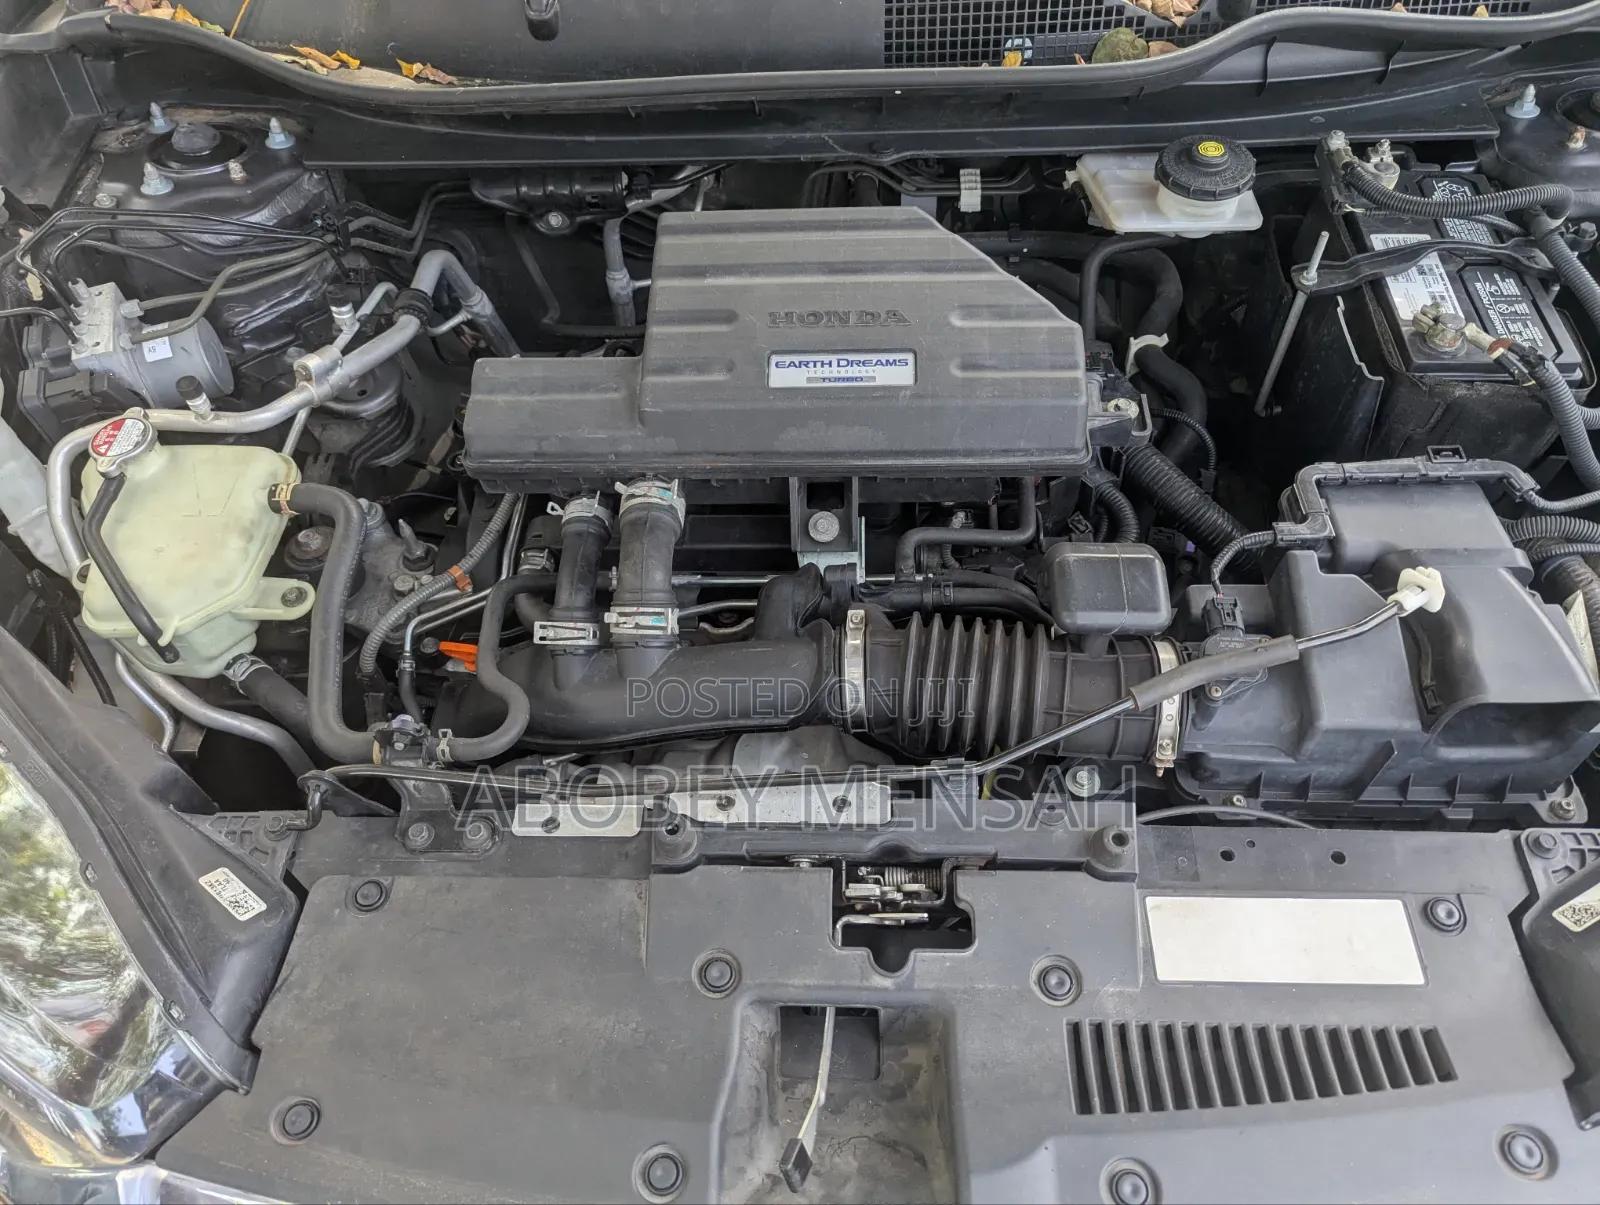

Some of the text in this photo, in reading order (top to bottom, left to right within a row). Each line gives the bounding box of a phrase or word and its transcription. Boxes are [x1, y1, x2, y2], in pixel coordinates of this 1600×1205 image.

[768, 309, 912, 328] HONDA
[1487, 309, 1506, 335] DANGER
[775, 359, 833, 369] EARTH
